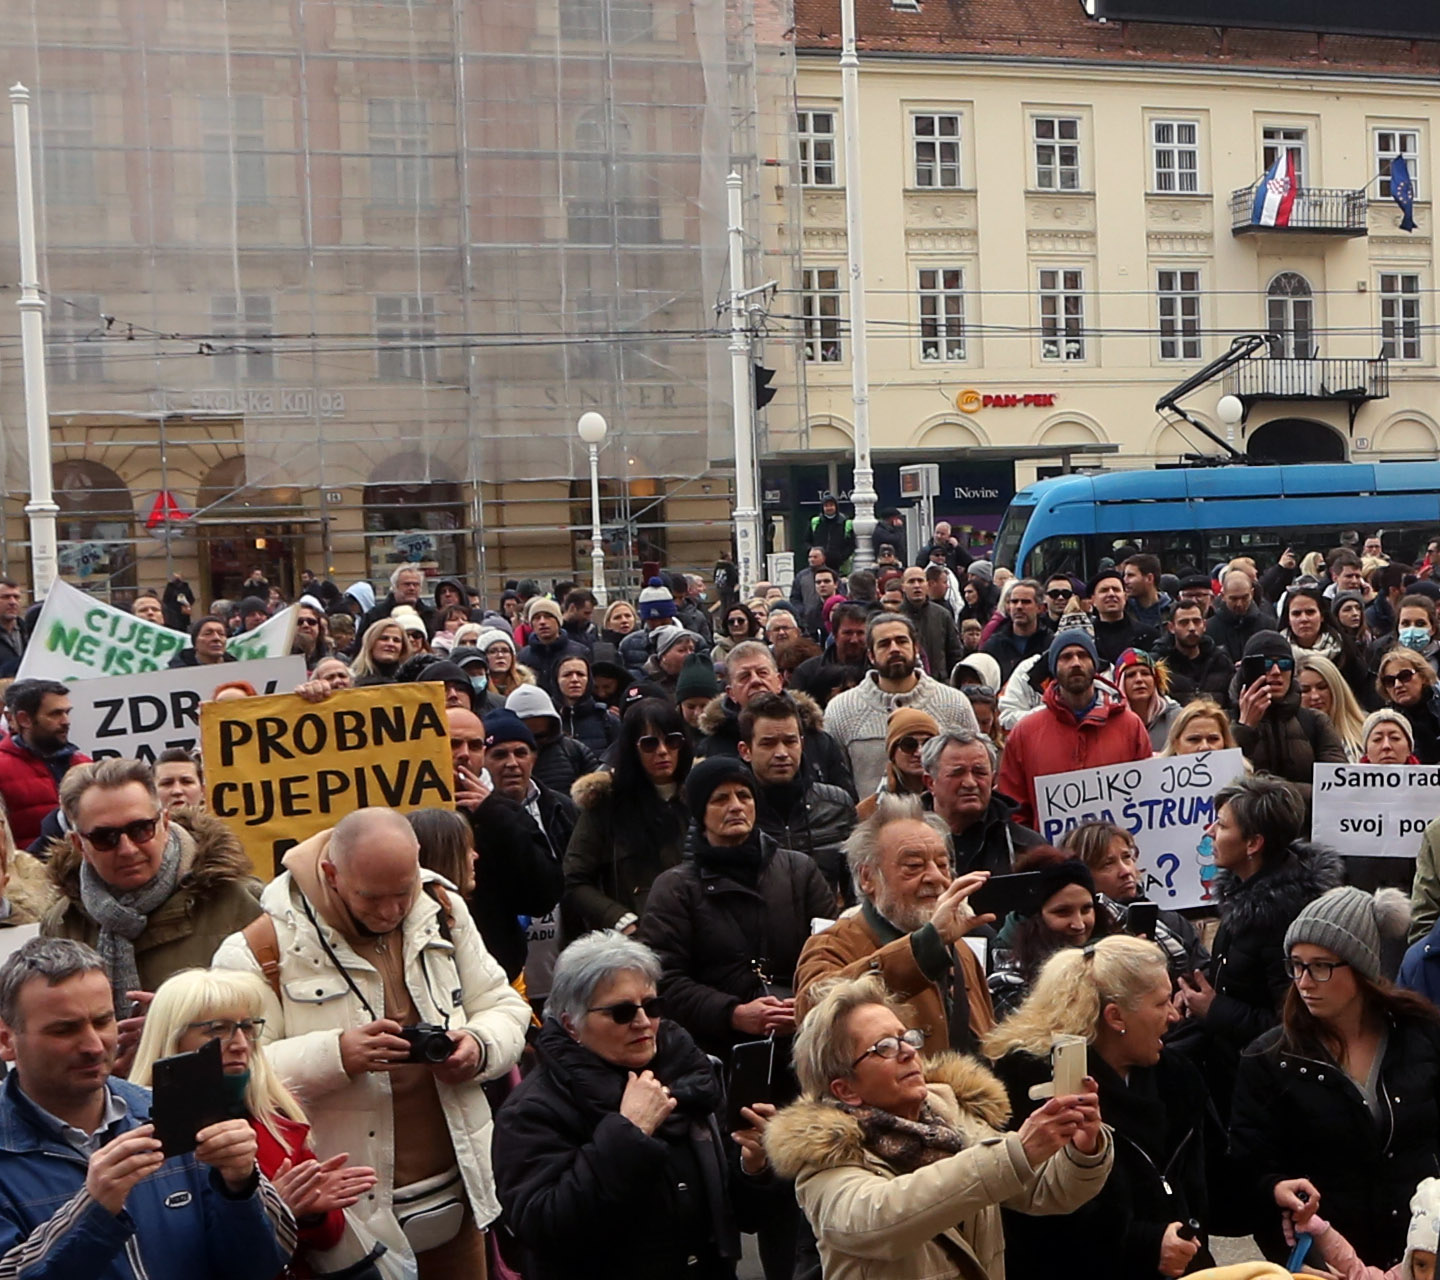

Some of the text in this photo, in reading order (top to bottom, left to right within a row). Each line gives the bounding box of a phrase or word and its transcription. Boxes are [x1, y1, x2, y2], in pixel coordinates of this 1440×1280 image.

[981, 394, 1055, 408] PAN-PEK
[46, 621, 101, 666] NE
[219, 702, 446, 767] PROBNA
[211, 759, 452, 826] CIJEPIVA
[1045, 752, 1213, 816] KOLIKO JOŠ
[1122, 794, 1218, 836] ŠTRUM
[1339, 813, 1383, 837] svoj
